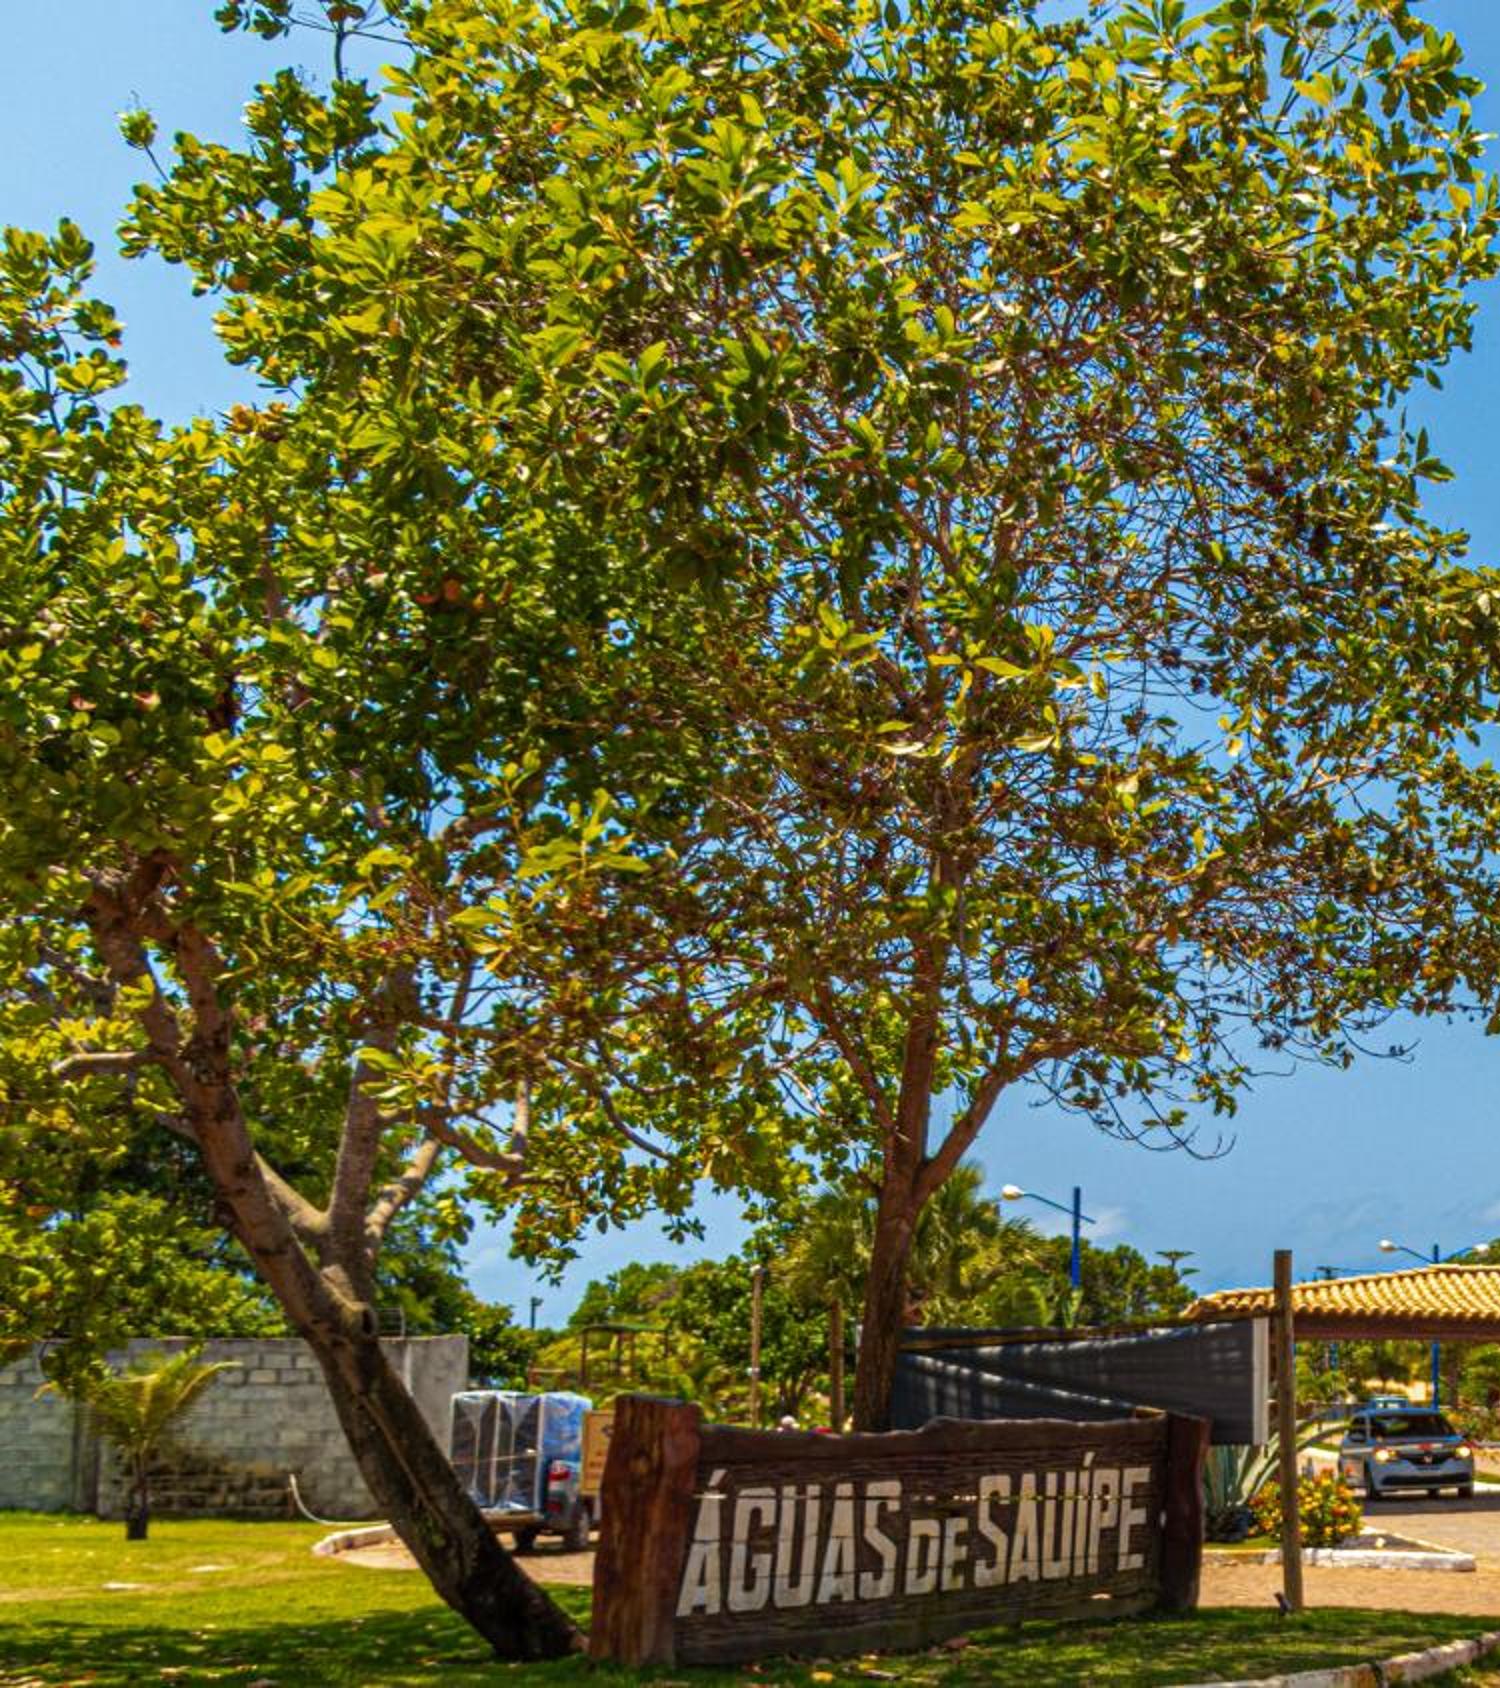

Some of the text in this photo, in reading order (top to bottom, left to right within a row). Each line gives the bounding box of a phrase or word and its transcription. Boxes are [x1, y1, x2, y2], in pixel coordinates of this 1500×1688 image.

[676, 1451, 1151, 1616] ÁGUAS DE SAUÍPE
